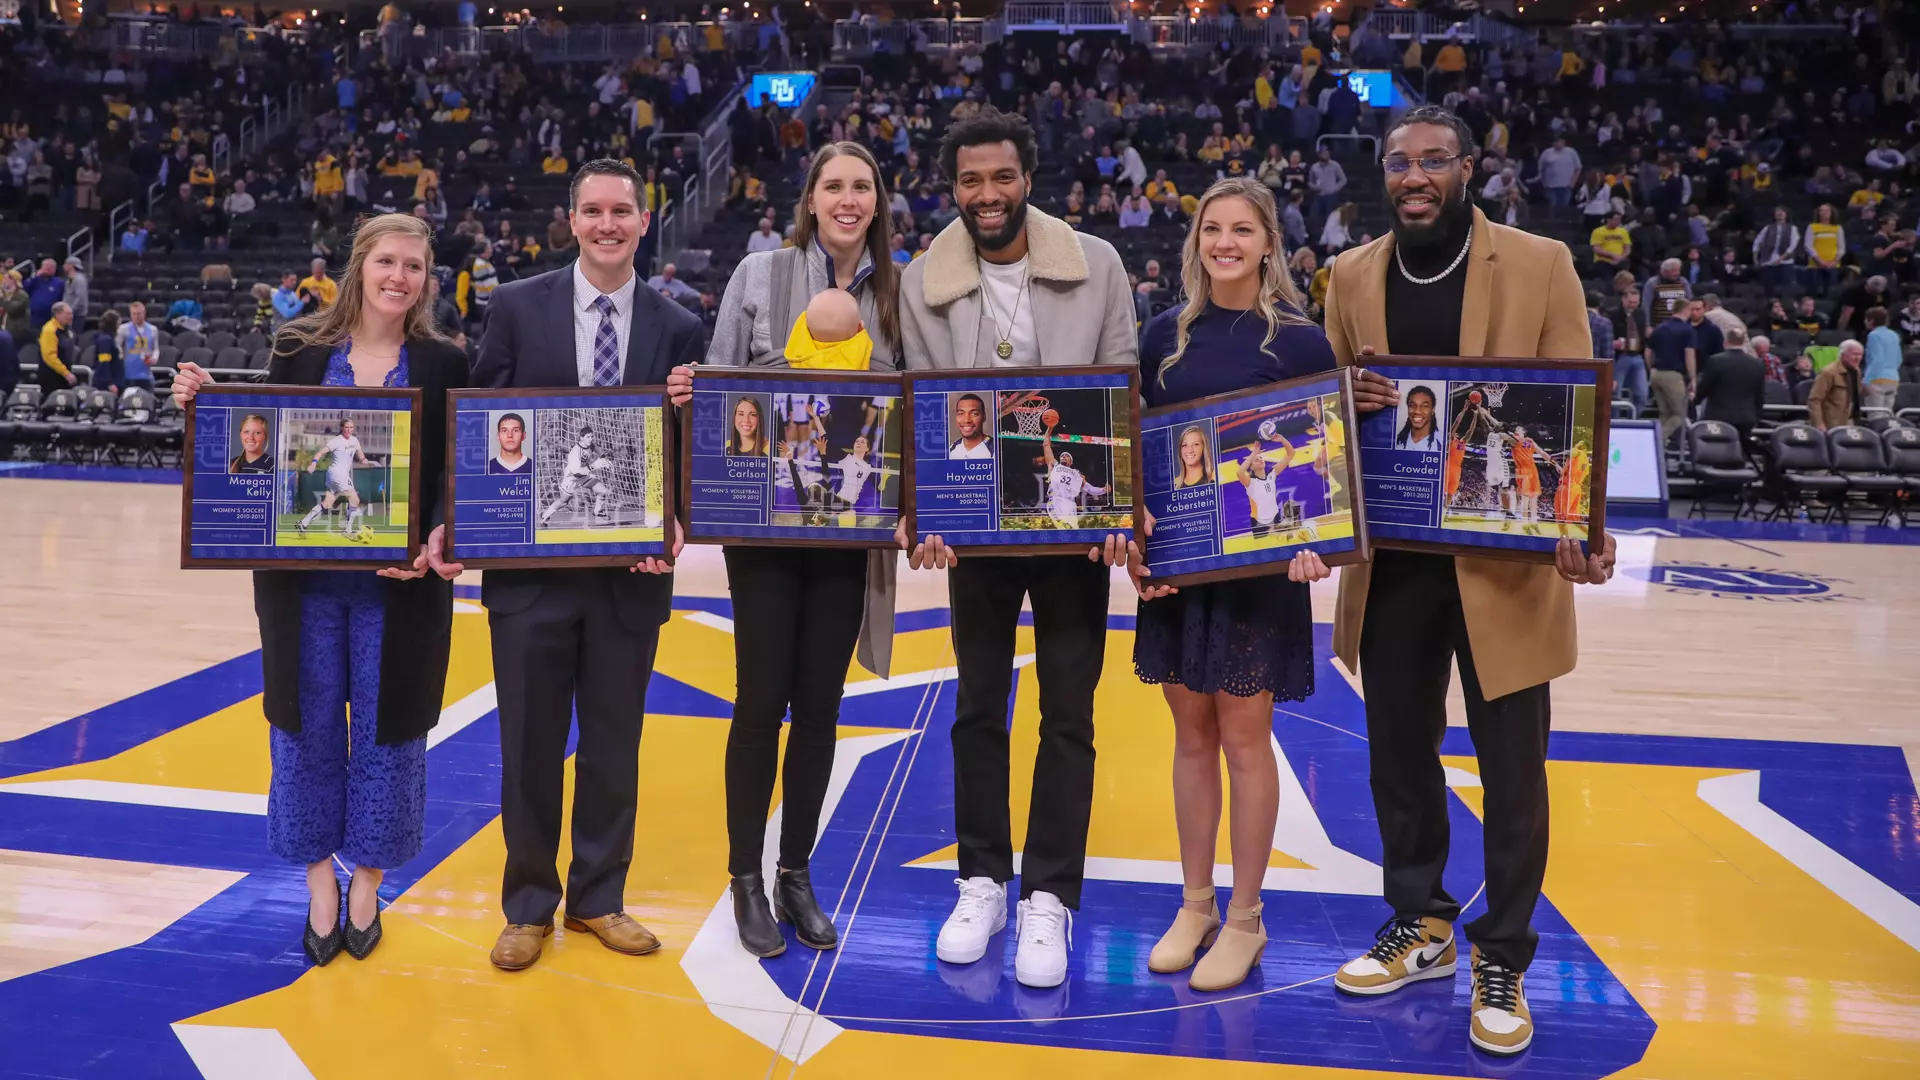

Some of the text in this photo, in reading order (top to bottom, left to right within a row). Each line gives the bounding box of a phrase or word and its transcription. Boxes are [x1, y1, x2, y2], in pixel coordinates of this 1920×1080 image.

[726, 458, 767, 468] Danielle
[1421, 453, 1439, 464] Jae
[965, 461, 993, 470] Lazar
[1393, 463, 1439, 475] Crowder
[728, 468, 766, 479] Carlson
[946, 471, 993, 484] Hayward
[229, 475, 272, 488] Maegan
[514, 476, 530, 486] Jim
[1060, 474, 1072, 486] 32
[246, 487, 272, 499] Kelly
[499, 486, 530, 496] Welch
[1171, 486, 1214, 502] Elizabeth
[1378, 483, 1431, 493] MEN'S BASKETBALL
[1166, 499, 1215, 513] Koberstein
[1155, 518, 1211, 532] WOMEN'S VOLLEYBALL
